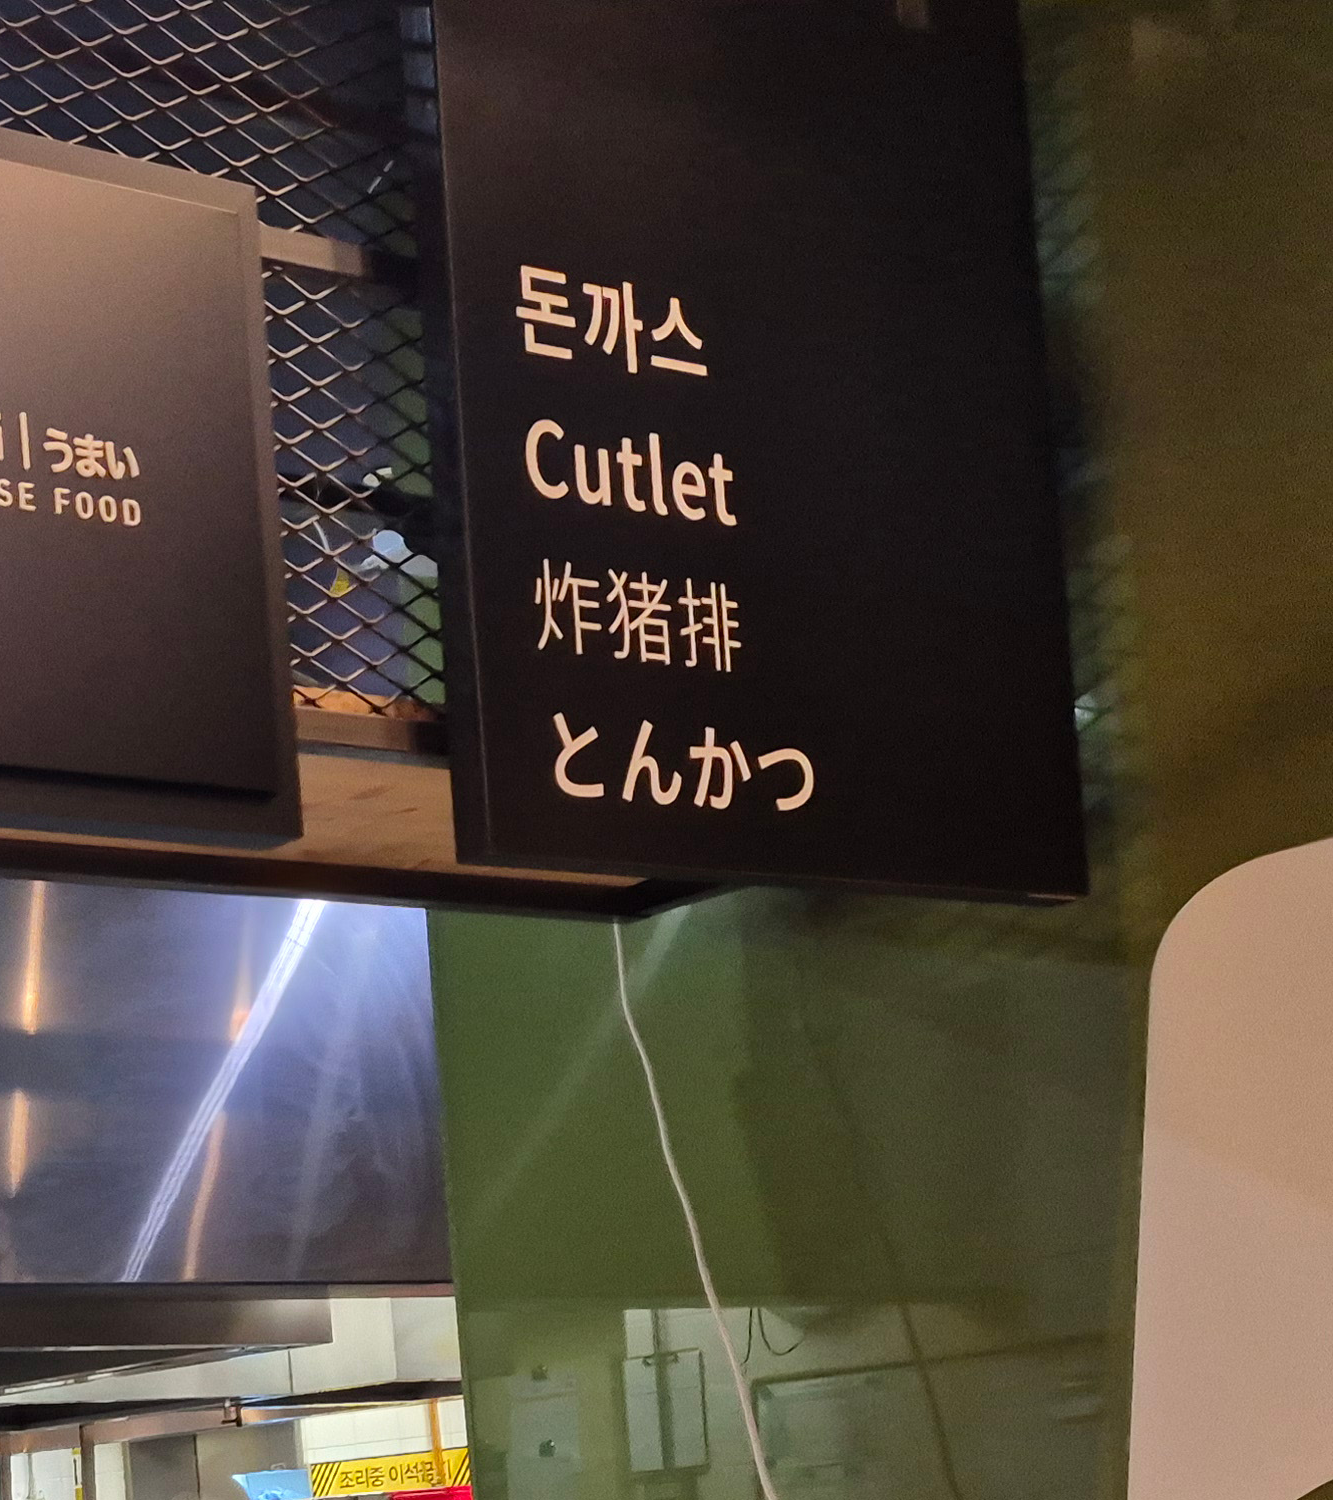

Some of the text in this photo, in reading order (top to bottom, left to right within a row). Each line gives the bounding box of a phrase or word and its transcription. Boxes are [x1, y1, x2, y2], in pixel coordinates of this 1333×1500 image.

[516, 264, 708, 377] 돈까스
[42, 427, 140, 480] うまい
[525, 419, 738, 526] Cutlet
[53, 487, 141, 527] FOOD
[534, 558, 742, 672] 炸猪排
[552, 712, 815, 811] とんかつ
[339, 1467, 384, 1489] 조리중
